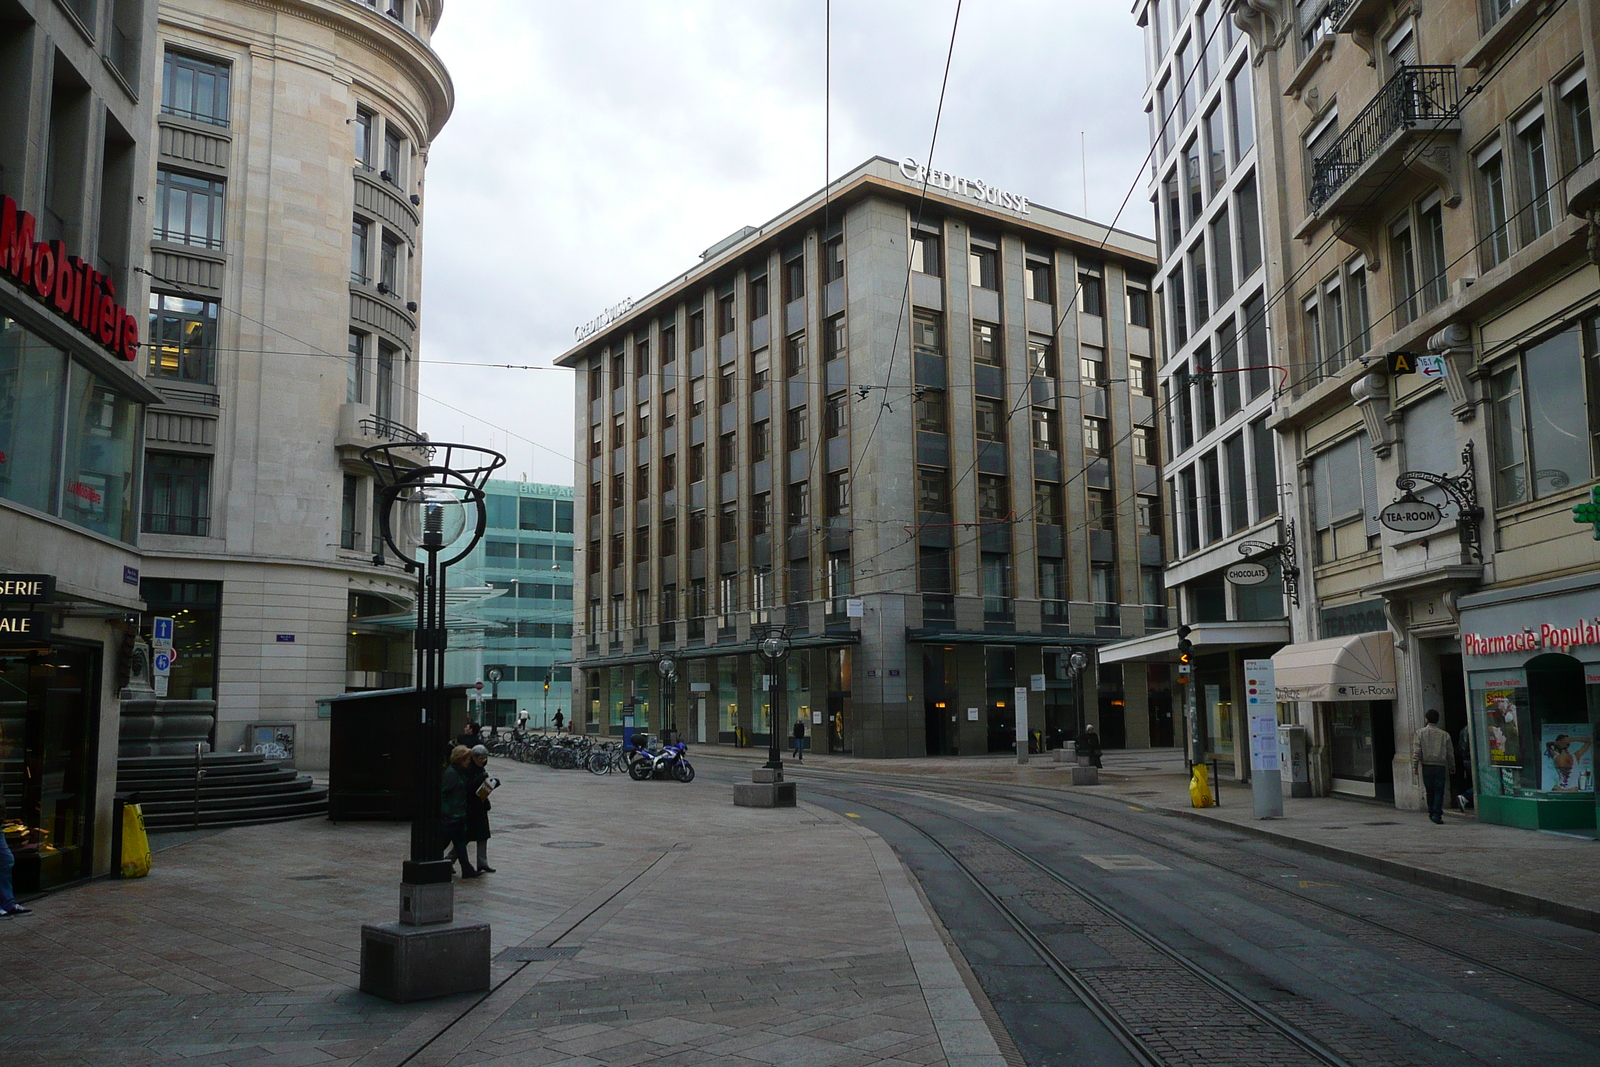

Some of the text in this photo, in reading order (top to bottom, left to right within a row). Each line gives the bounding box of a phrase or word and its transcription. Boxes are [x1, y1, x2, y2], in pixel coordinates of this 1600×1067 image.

[973, 177, 1031, 215] SUISSE
[0, 195, 138, 361] Mobilière
[1394, 354, 1410, 371] A
[519, 484, 546, 496] BNP
[1385, 511, 1436, 522] TEA-ROOM
[1229, 569, 1266, 579] CHOCOLATS
[1428, 602, 1435, 615] 3
[1465, 626, 1536, 656] Pharmacie
[1349, 685, 1396, 696] TEA-ROOM
